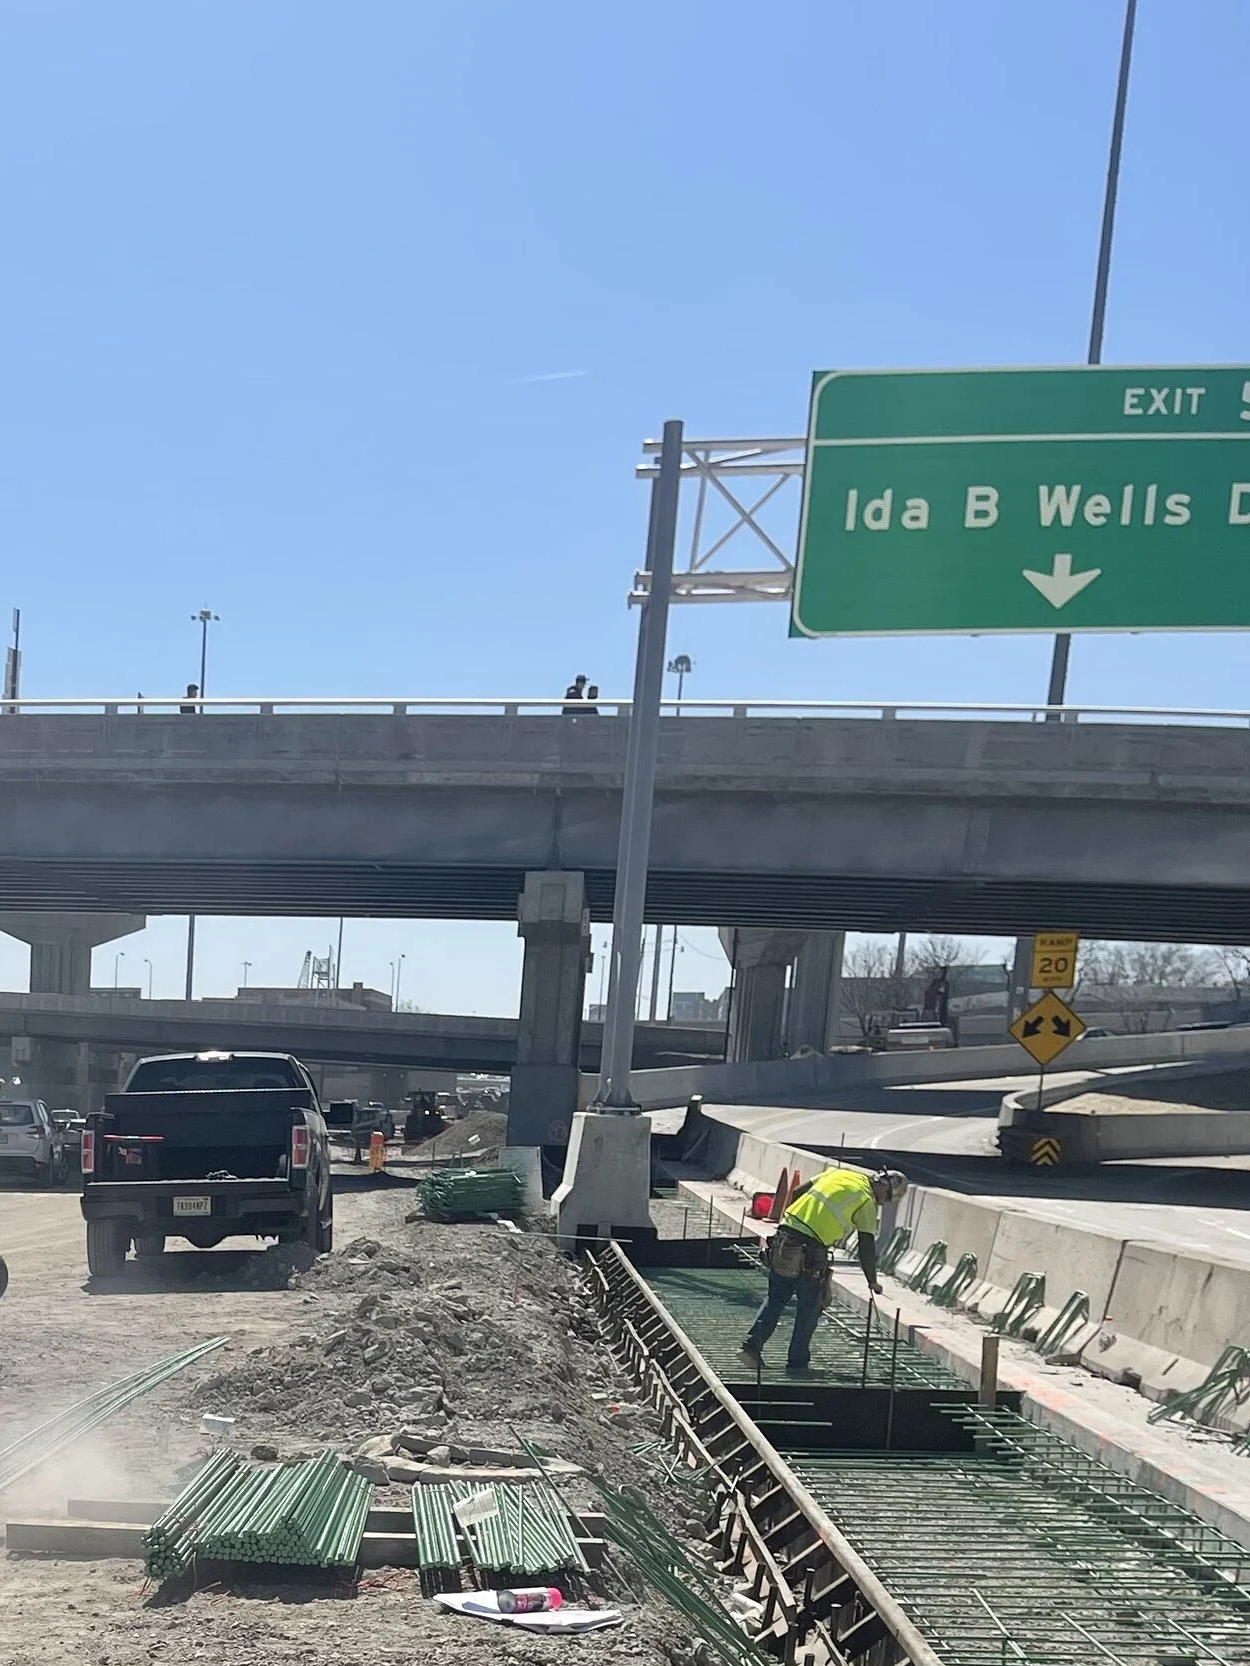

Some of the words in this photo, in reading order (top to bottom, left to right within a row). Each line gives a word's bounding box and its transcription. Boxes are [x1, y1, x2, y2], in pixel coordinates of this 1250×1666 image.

[1123, 387, 1207, 416] EXIT
[845, 488, 930, 532] Ida
[964, 486, 1000, 529] B
[1038, 483, 1192, 527] Wells
[1038, 957, 1069, 974] 20
